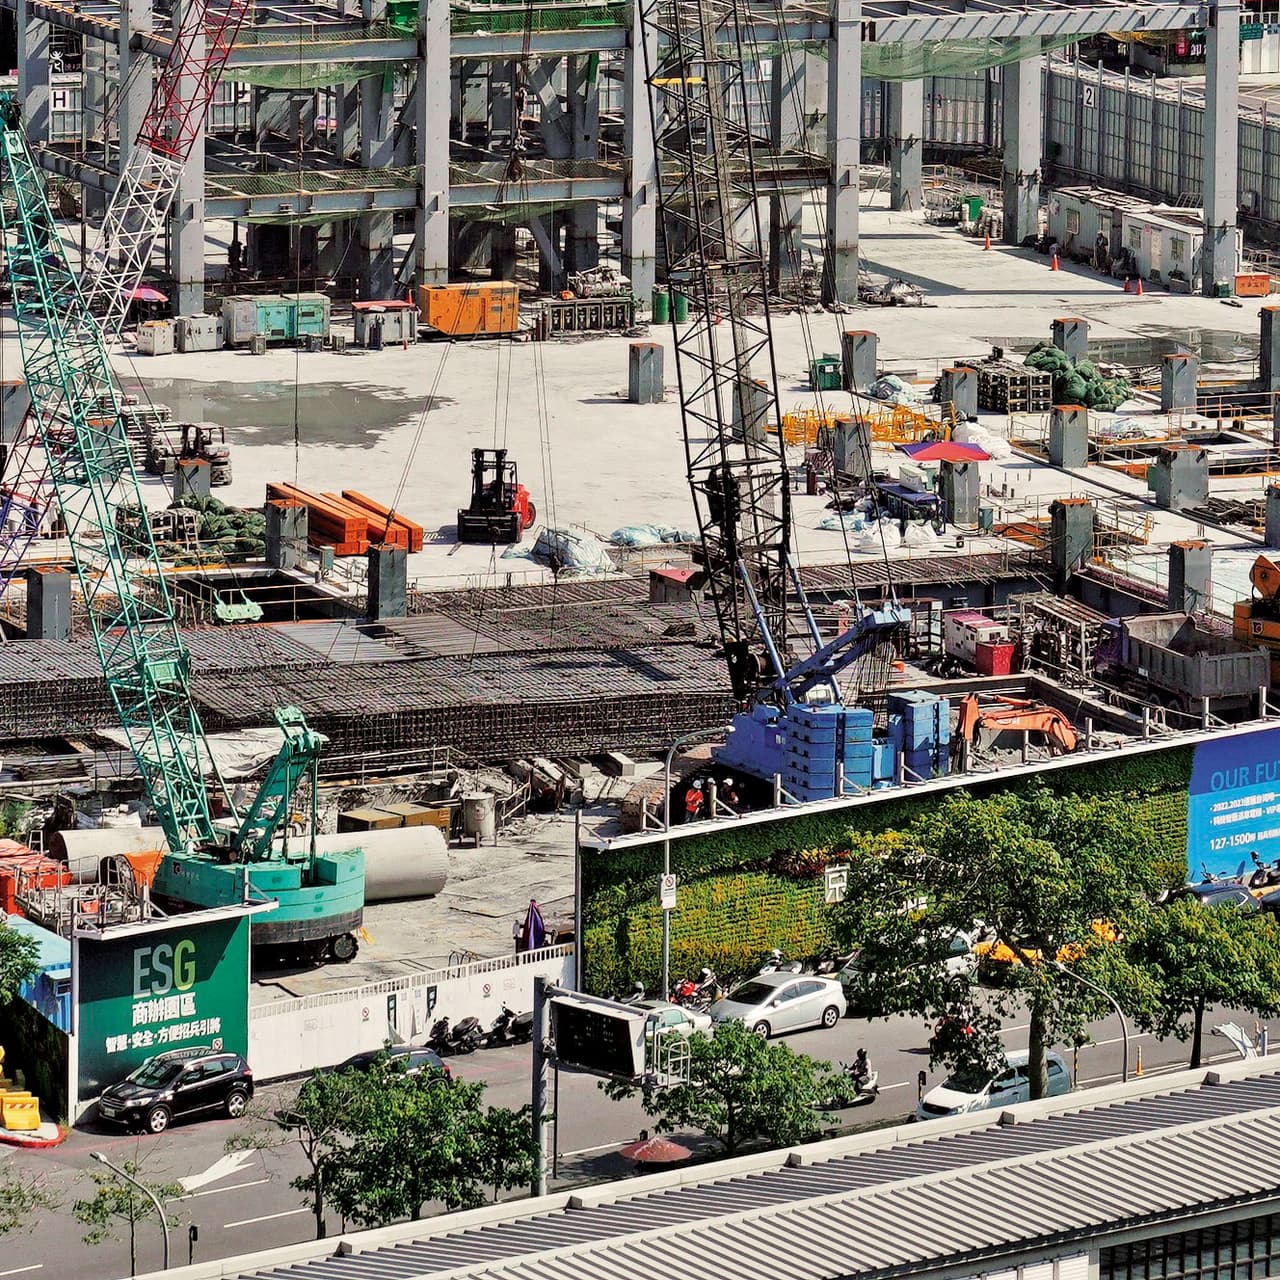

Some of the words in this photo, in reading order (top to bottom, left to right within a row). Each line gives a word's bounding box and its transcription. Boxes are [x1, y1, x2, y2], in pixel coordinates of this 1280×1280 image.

[53, 91, 66, 108] H
[1085, 88, 1093, 105] 2
[1210, 766, 1250, 791] OUR
[133, 939, 196, 1000] ESG
[132, 992, 196, 1027] 商辦園區
